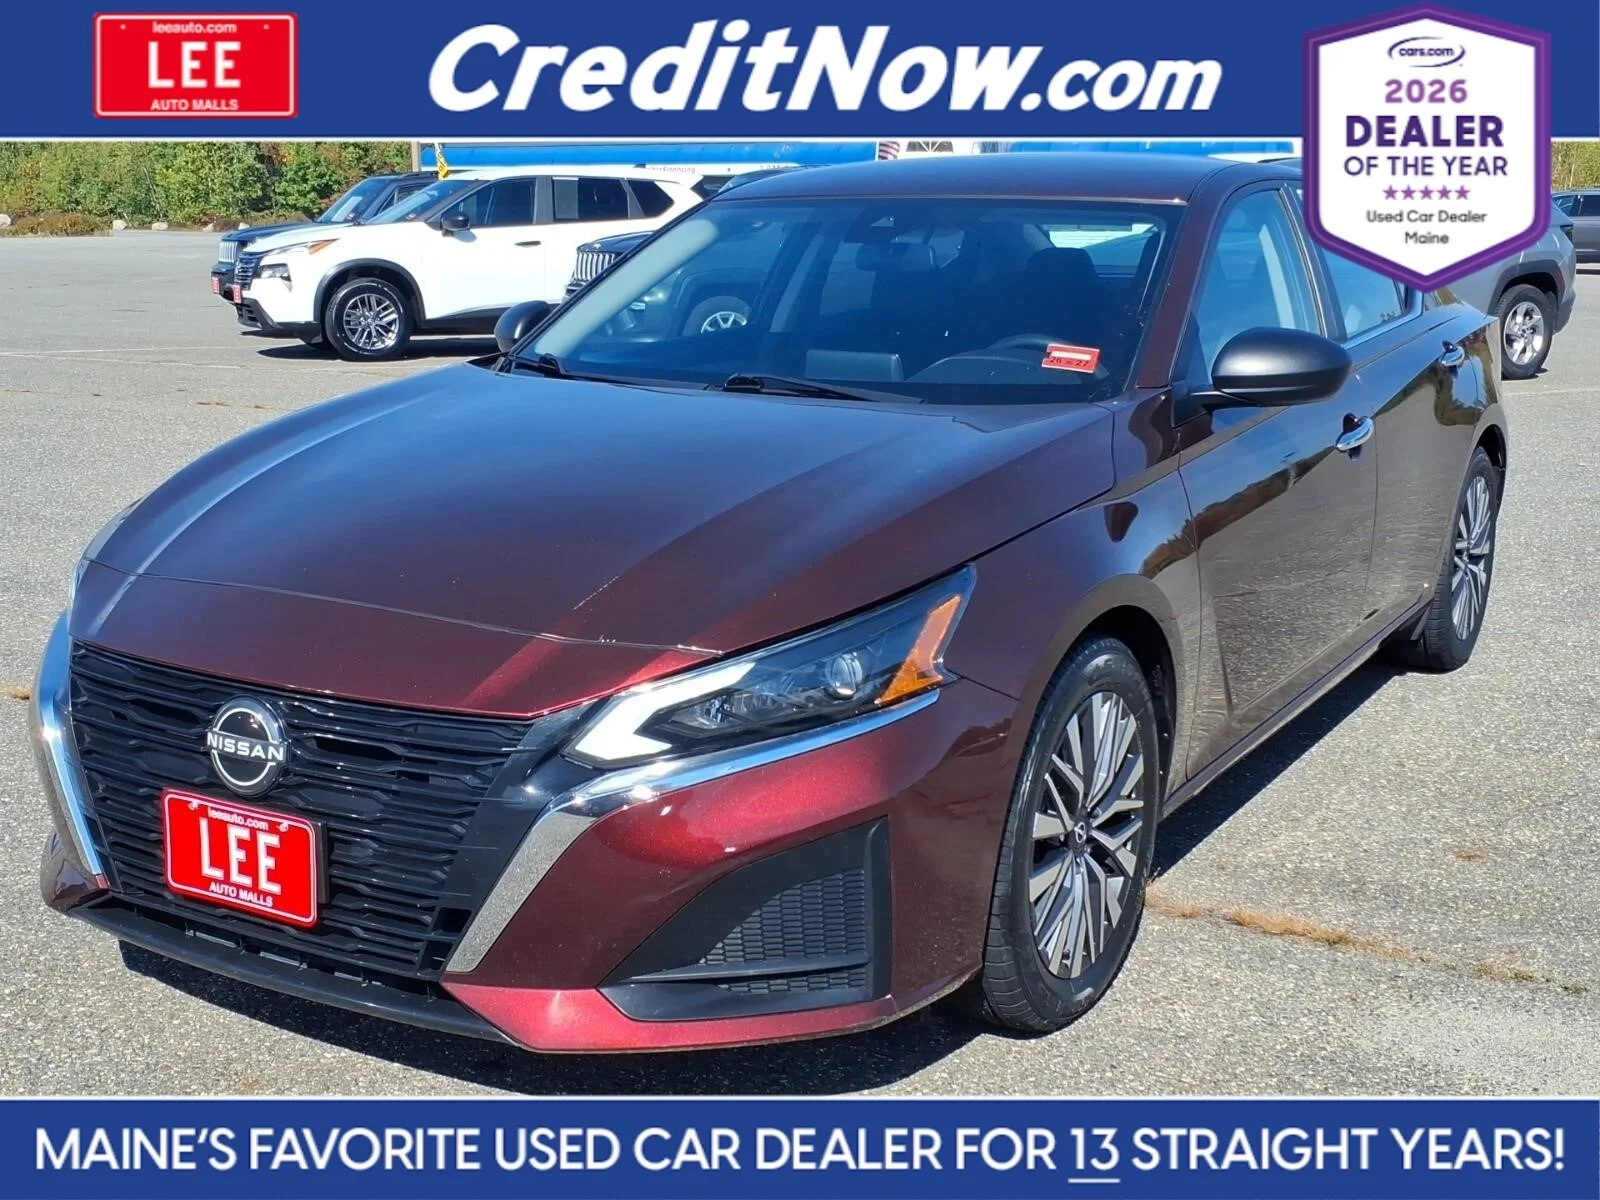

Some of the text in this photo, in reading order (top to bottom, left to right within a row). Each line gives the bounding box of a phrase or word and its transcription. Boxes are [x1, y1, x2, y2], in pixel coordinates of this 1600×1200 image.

[206, 731, 285, 762] NISSAN
[207, 806, 269, 831] leeauto.com
[199, 816, 282, 896] LEE
[209, 881, 274, 908] AUTO MALLS
